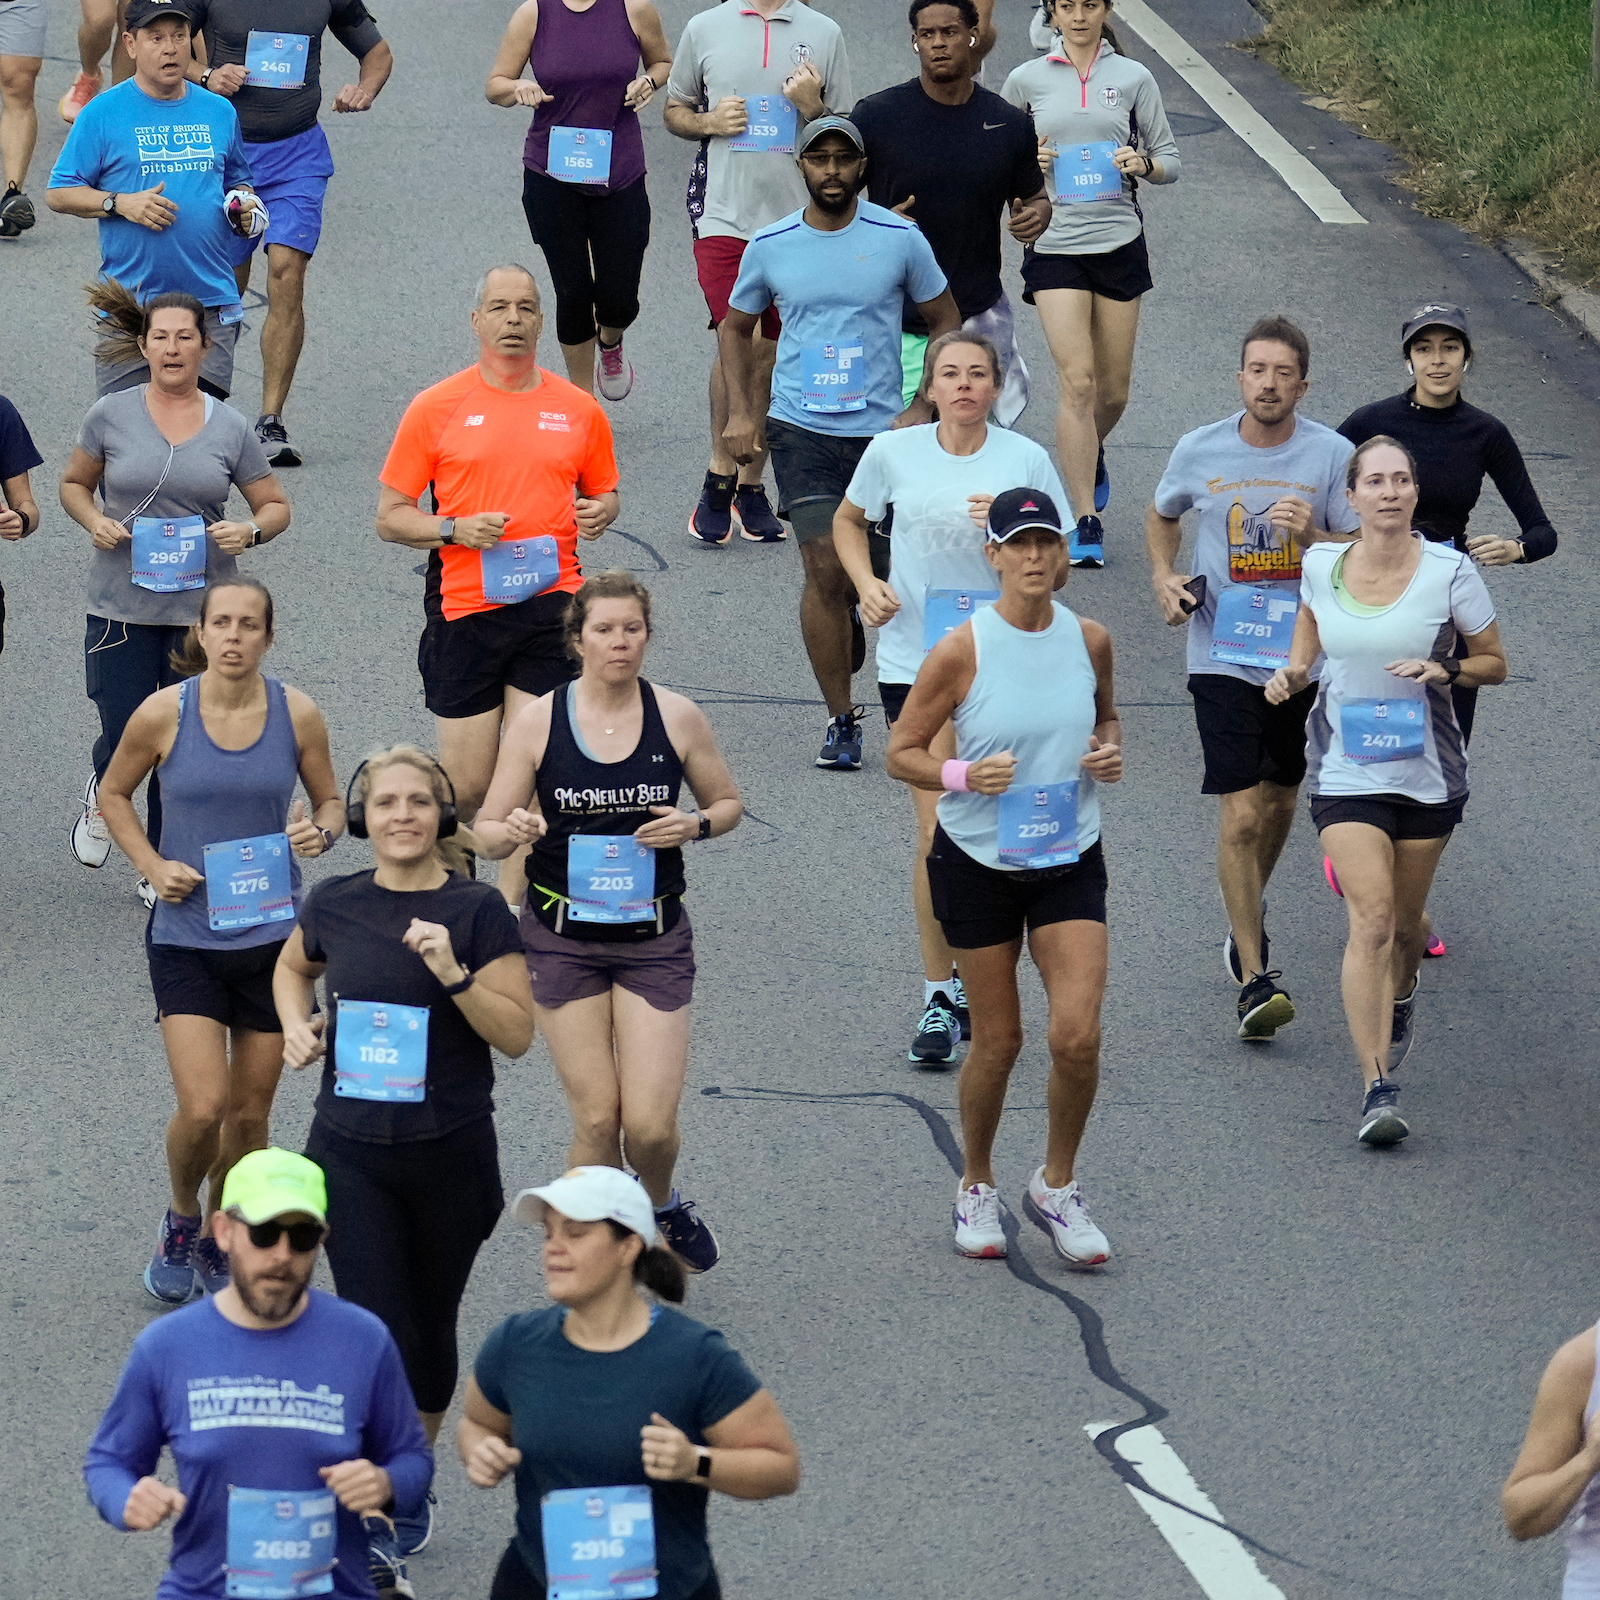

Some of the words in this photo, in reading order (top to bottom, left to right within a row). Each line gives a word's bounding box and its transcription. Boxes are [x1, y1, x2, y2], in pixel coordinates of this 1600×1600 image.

[260, 60, 290, 72] 2461
[133, 126, 154, 136] CITY
[157, 125, 171, 134] OF
[172, 124, 210, 134] BRIDGES
[747, 125, 777, 136] 1539
[136, 134, 168, 147] RUN
[173, 132, 212, 145] CLUB
[140, 159, 214, 177] pittsburgh
[564, 156, 592, 168] 1565
[1073, 173, 1103, 186] 1819
[812, 372, 849, 385] 2798
[539, 411, 566, 421] acea
[148, 551, 187, 565] 2967
[502, 572, 540, 588] 2071
[1233, 621, 1272, 637] 2781
[1217, 651, 1238, 662] Gear
[1239, 655, 1260, 665] Check
[1362, 732, 1400, 747] 2471
[1018, 820, 1059, 837] 2290
[229, 877, 270, 895] 1276
[589, 875, 634, 891] 2203
[358, 1047, 398, 1064] 1182
[188, 1398, 235, 1420] HALF
[235, 1397, 345, 1424] MARATHON
[254, 1539, 311, 1560] 2682
